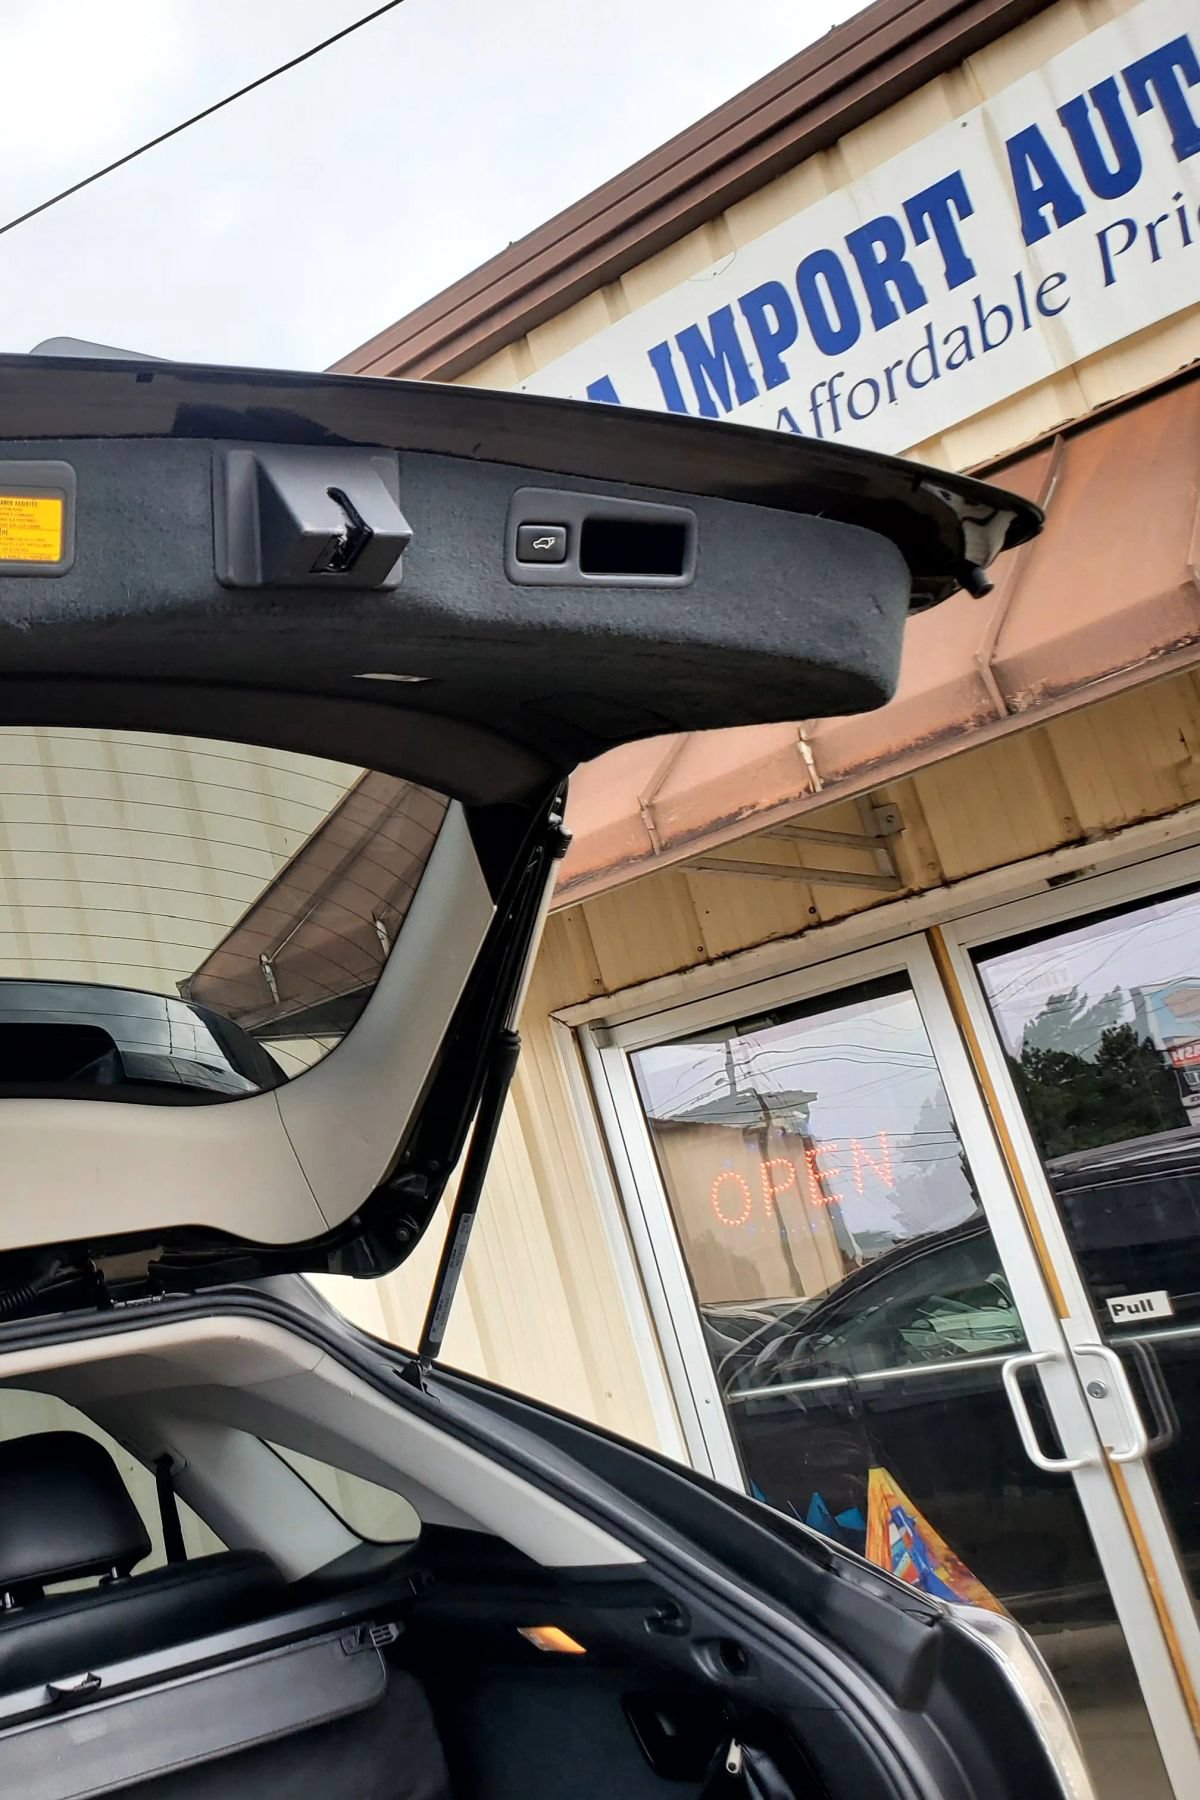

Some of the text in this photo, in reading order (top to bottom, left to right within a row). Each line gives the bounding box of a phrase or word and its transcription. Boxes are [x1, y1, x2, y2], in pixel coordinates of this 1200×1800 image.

[647, 169, 978, 418] IMPORT
[777, 190, 1200, 439] Affordable Pri
[711, 1128, 895, 1226] OPEN
[1111, 1299, 1154, 1316] Pull
